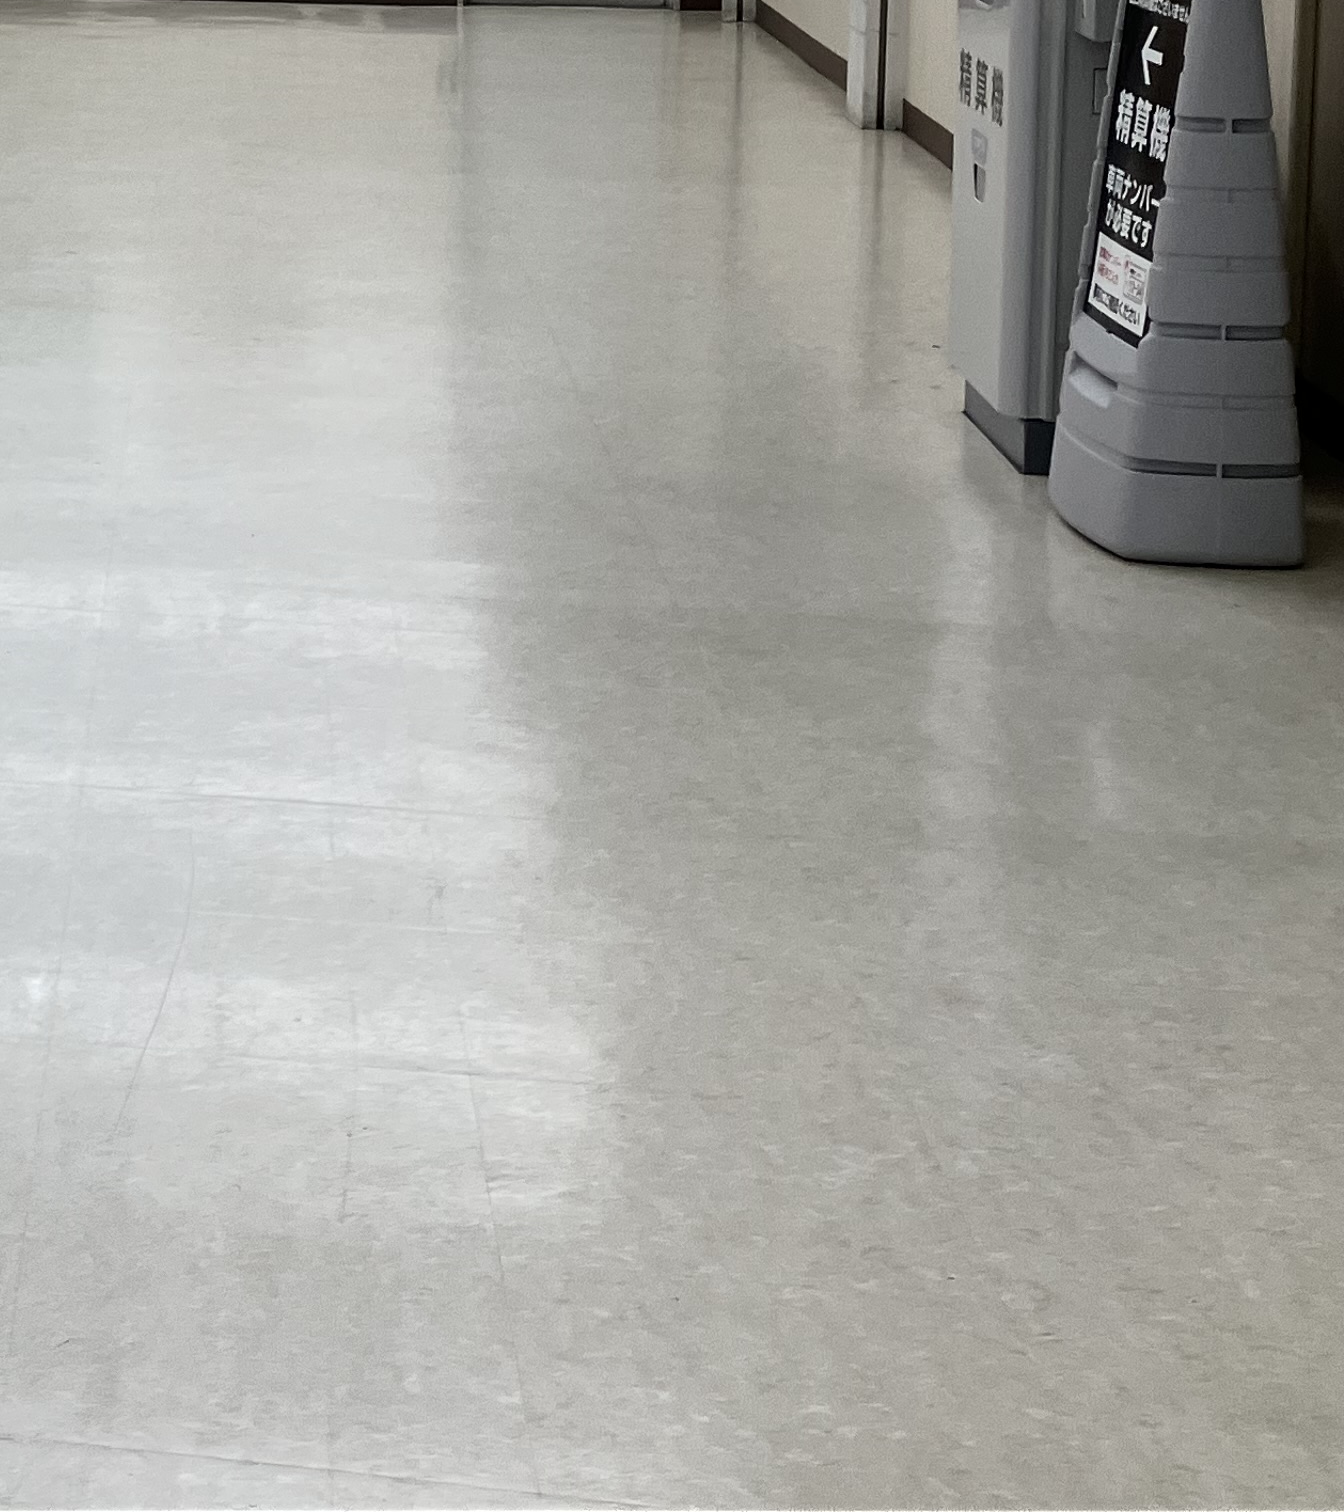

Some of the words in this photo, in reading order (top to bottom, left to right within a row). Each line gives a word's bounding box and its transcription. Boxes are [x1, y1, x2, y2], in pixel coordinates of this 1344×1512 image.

[960, 48, 1004, 127] 精算機
[1115, 89, 1171, 162] 精算機
[1105, 164, 1161, 212] 車両ナンバー
[1105, 199, 1153, 248] が必要です
